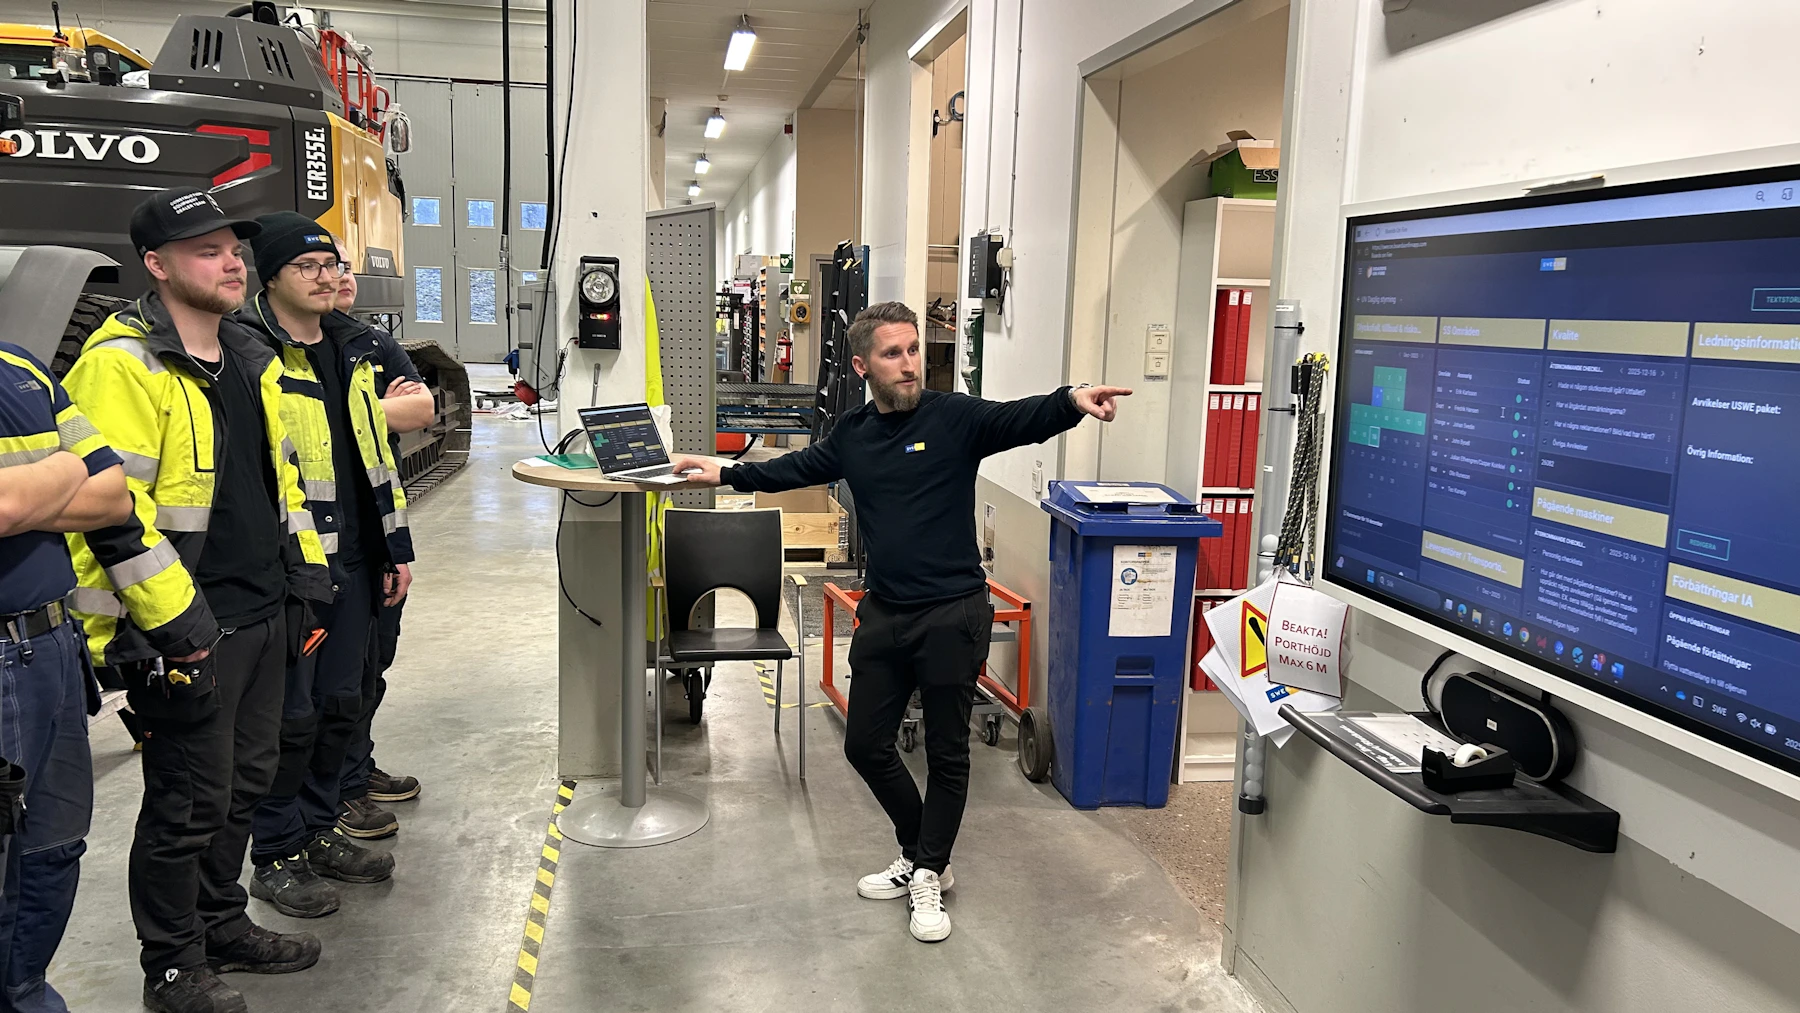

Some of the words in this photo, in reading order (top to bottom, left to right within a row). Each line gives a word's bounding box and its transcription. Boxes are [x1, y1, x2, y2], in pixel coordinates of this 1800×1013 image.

[0, 129, 160, 164] OLVO
[1253, 169, 1278, 182] ESS
[371, 256, 389, 268] VOLVO
[1627, 367, 1656, 377] 2025-12-16
[1692, 397, 1729, 408] Avvikelser
[1731, 401, 1754, 412] USWE
[1755, 404, 1780, 414] paket:
[1687, 445, 1706, 458] Övrig
[1707, 448, 1753, 463] Information:
[1537, 497, 1574, 516] Pågående
[1575, 506, 1614, 524] maskiner
[1425, 540, 1461, 558] Leverantörer
[1609, 549, 1636, 561] 2025-12-16
[1672, 574, 1738, 605] Förbättringar
[1741, 593, 1753, 608] IA
[1668, 611, 1686, 622] ÖPPNA
[1687, 617, 1730, 636] FÖRBÄTTRINGAR
[1666, 635, 1700, 654] Pågående
[1702, 647, 1751, 672] förbättringar:
[1306, 660, 1314, 671] 6
[1316, 662, 1327, 674] M
[1664, 659, 1678, 672] Flytta
[1712, 702, 1726, 717] SWE
